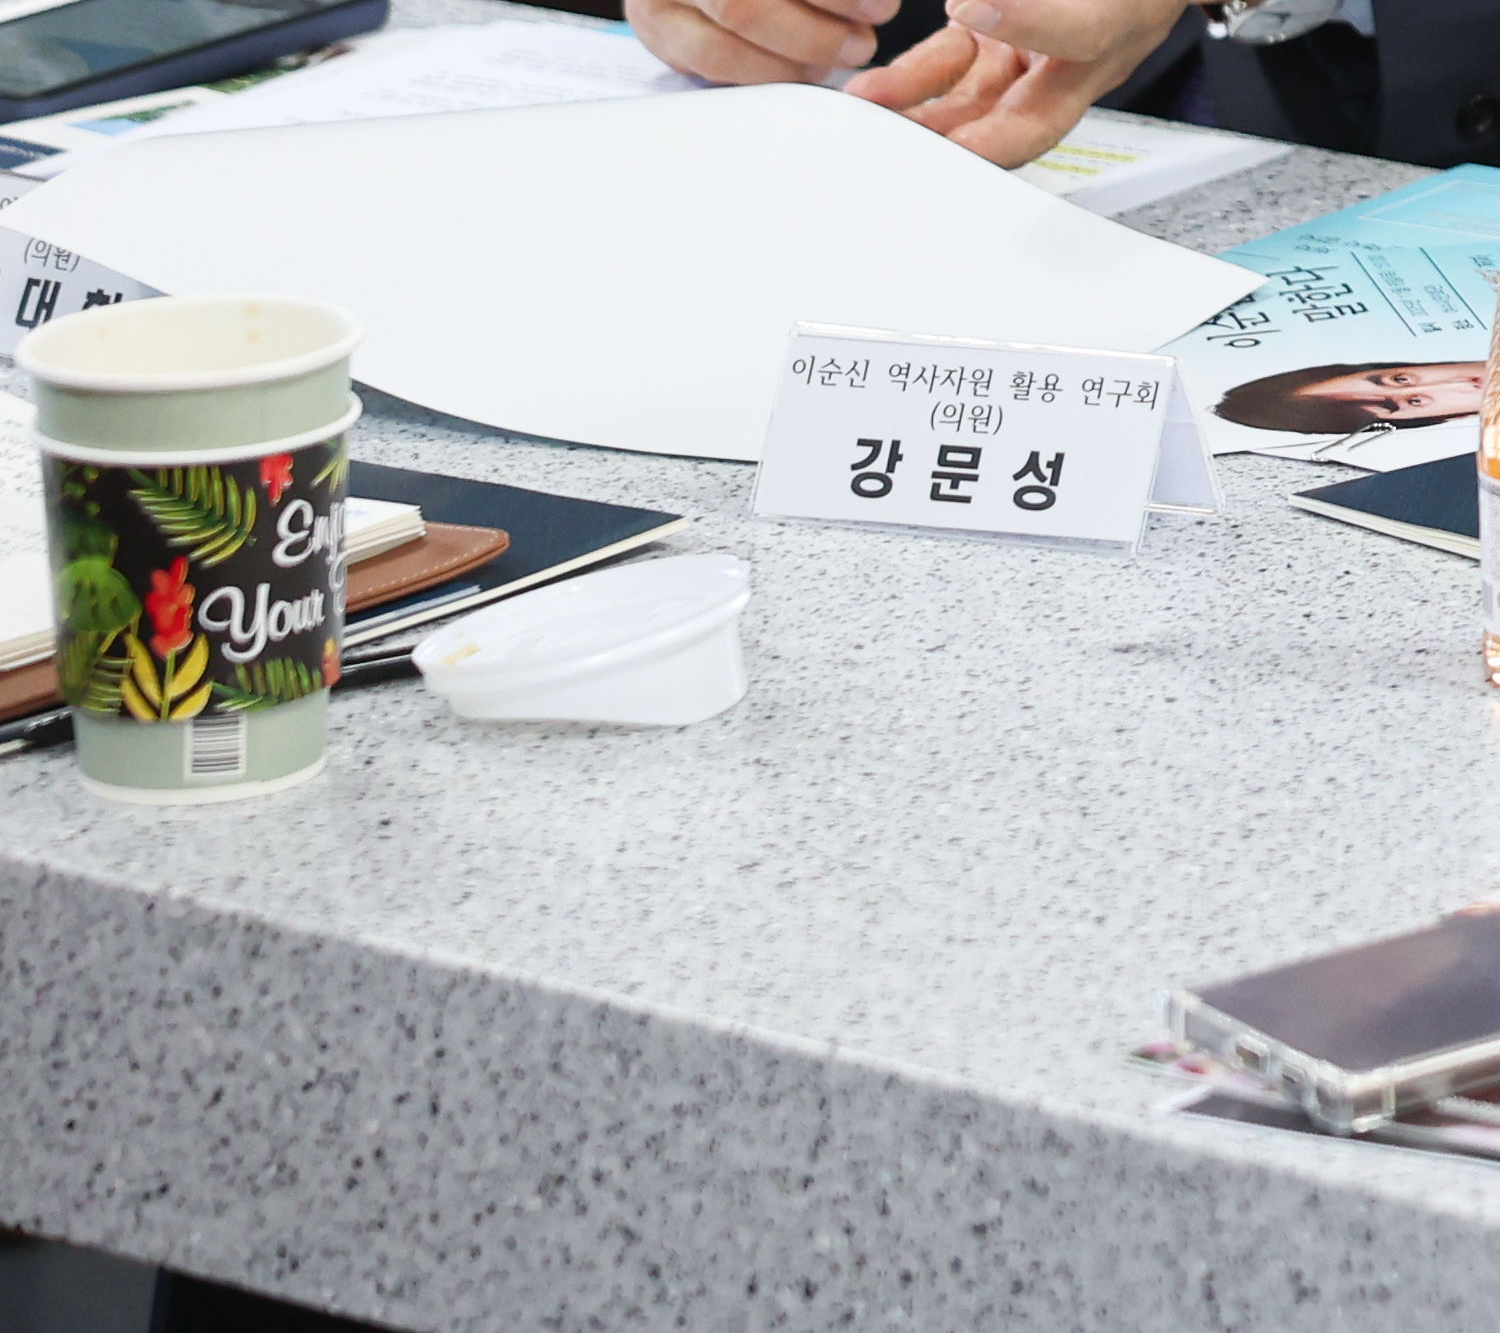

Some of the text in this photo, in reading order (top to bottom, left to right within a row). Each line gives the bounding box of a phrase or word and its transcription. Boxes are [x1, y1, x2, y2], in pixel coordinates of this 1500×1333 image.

[1265, 265, 1369, 323] 말한다
[792, 355, 1160, 411] 이순신 역사자원 활용 연구회
[930, 401, 1003, 435] (의원)
[198, 583, 325, 663] Your
